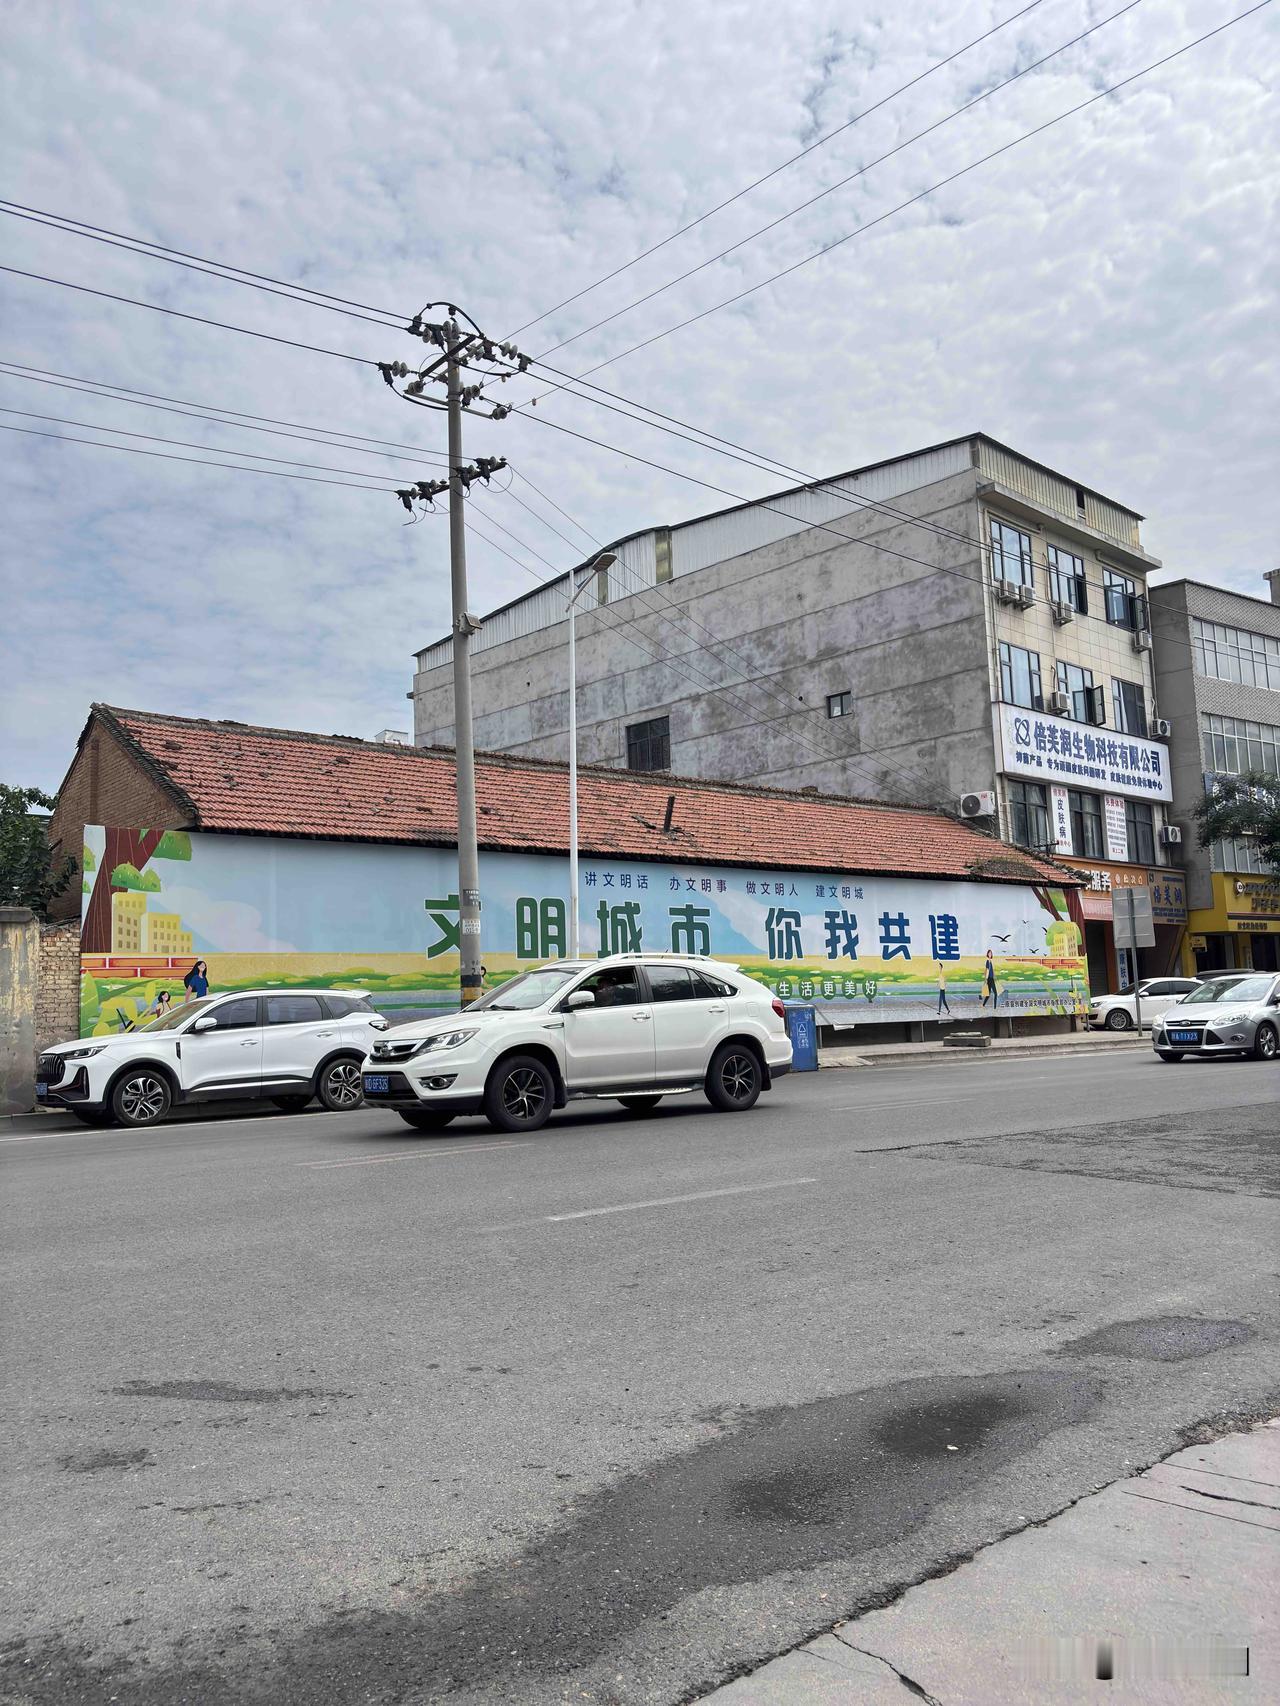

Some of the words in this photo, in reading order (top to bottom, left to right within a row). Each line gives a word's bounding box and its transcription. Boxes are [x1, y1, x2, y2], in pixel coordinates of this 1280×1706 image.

[1034, 721, 1161, 776] 倍芙润生物科技有限公司
[585, 872, 648, 889] 讲文明话
[669, 877, 727, 893] 办文明事
[746, 880, 799, 896] 做文明人
[815, 884, 864, 900] 建文明城
[765, 907, 961, 961] 你我共建
[762, 981, 876, 996] 生活更美好
